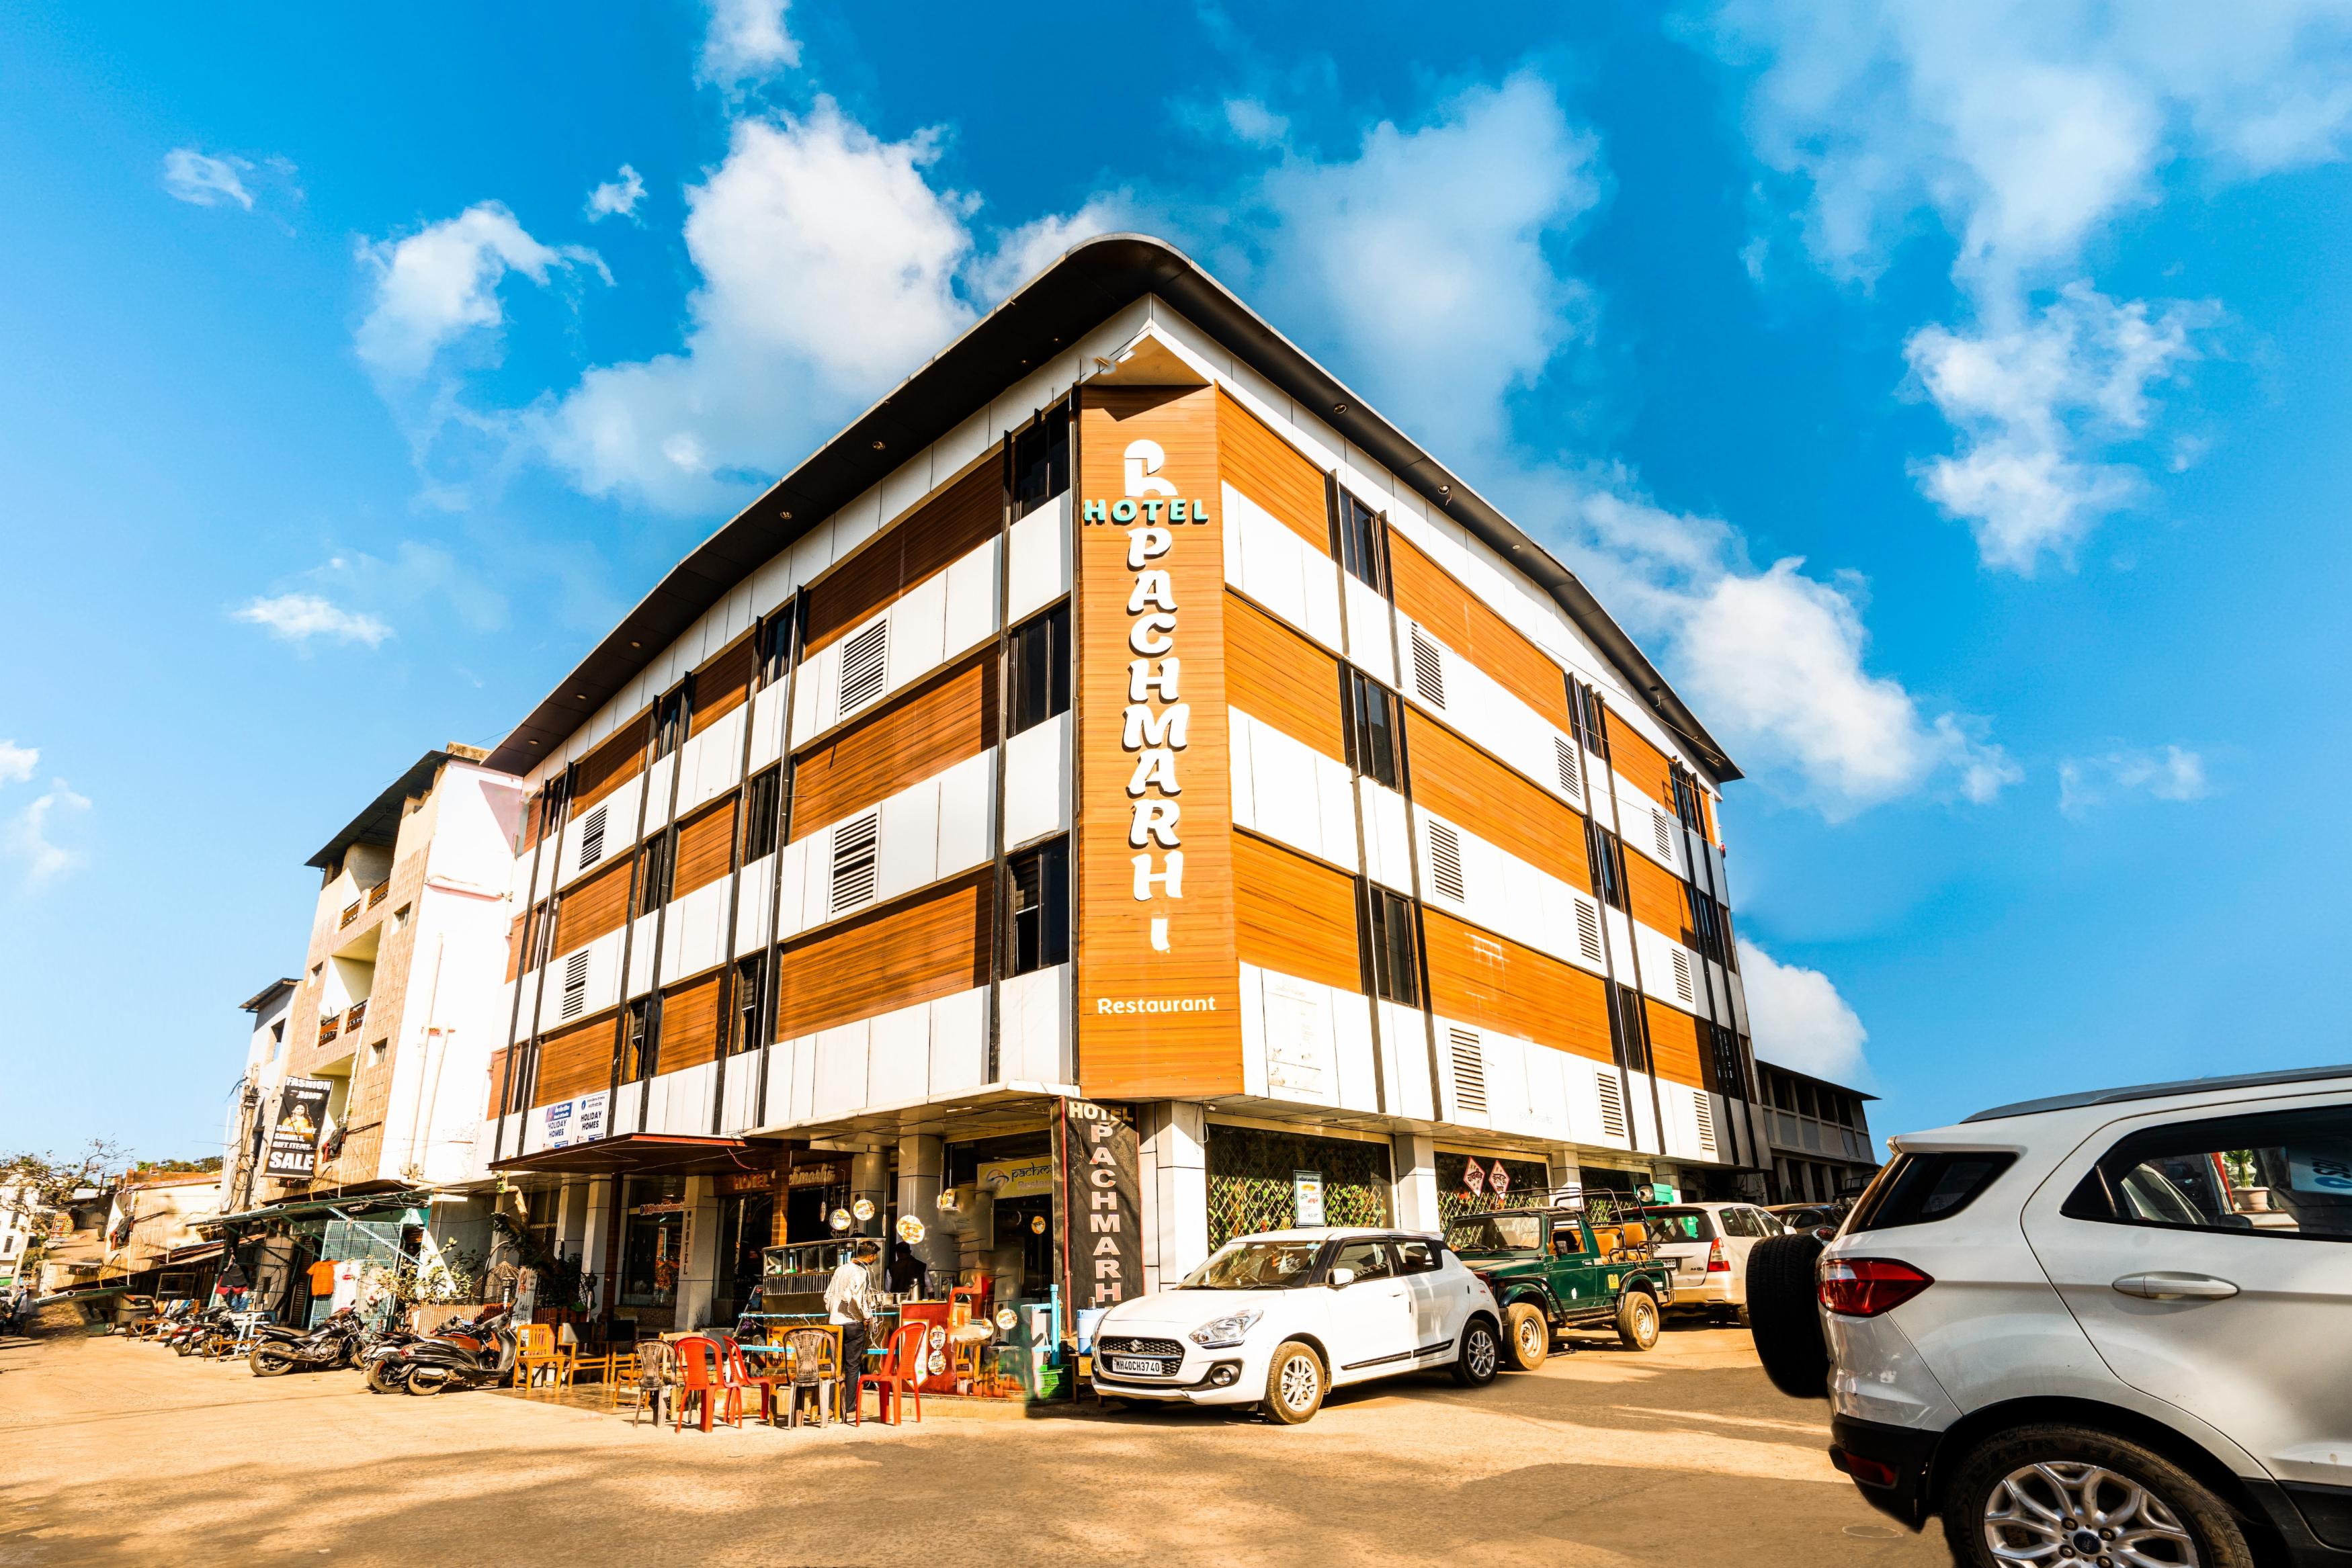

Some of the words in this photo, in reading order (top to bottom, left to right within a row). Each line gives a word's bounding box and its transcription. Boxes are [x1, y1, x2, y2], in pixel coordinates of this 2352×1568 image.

[1083, 499, 1209, 525] HOTEL
[1097, 996, 1216, 1014] Restaurant
[286, 1076, 331, 1091] FASHION
[581, 1110, 602, 1122] HOLIDAY
[1068, 1102, 1134, 1122] HOTEL
[548, 1119, 567, 1129] HOLIDAY
[582, 1121, 599, 1131] HOMES
[549, 1129, 564, 1138] HOMES
[269, 1151, 315, 1171] SALE
[1089, 1124, 1122, 1309] PACHMARH
[1116, 1360, 1160, 1372] MH40CH3740
